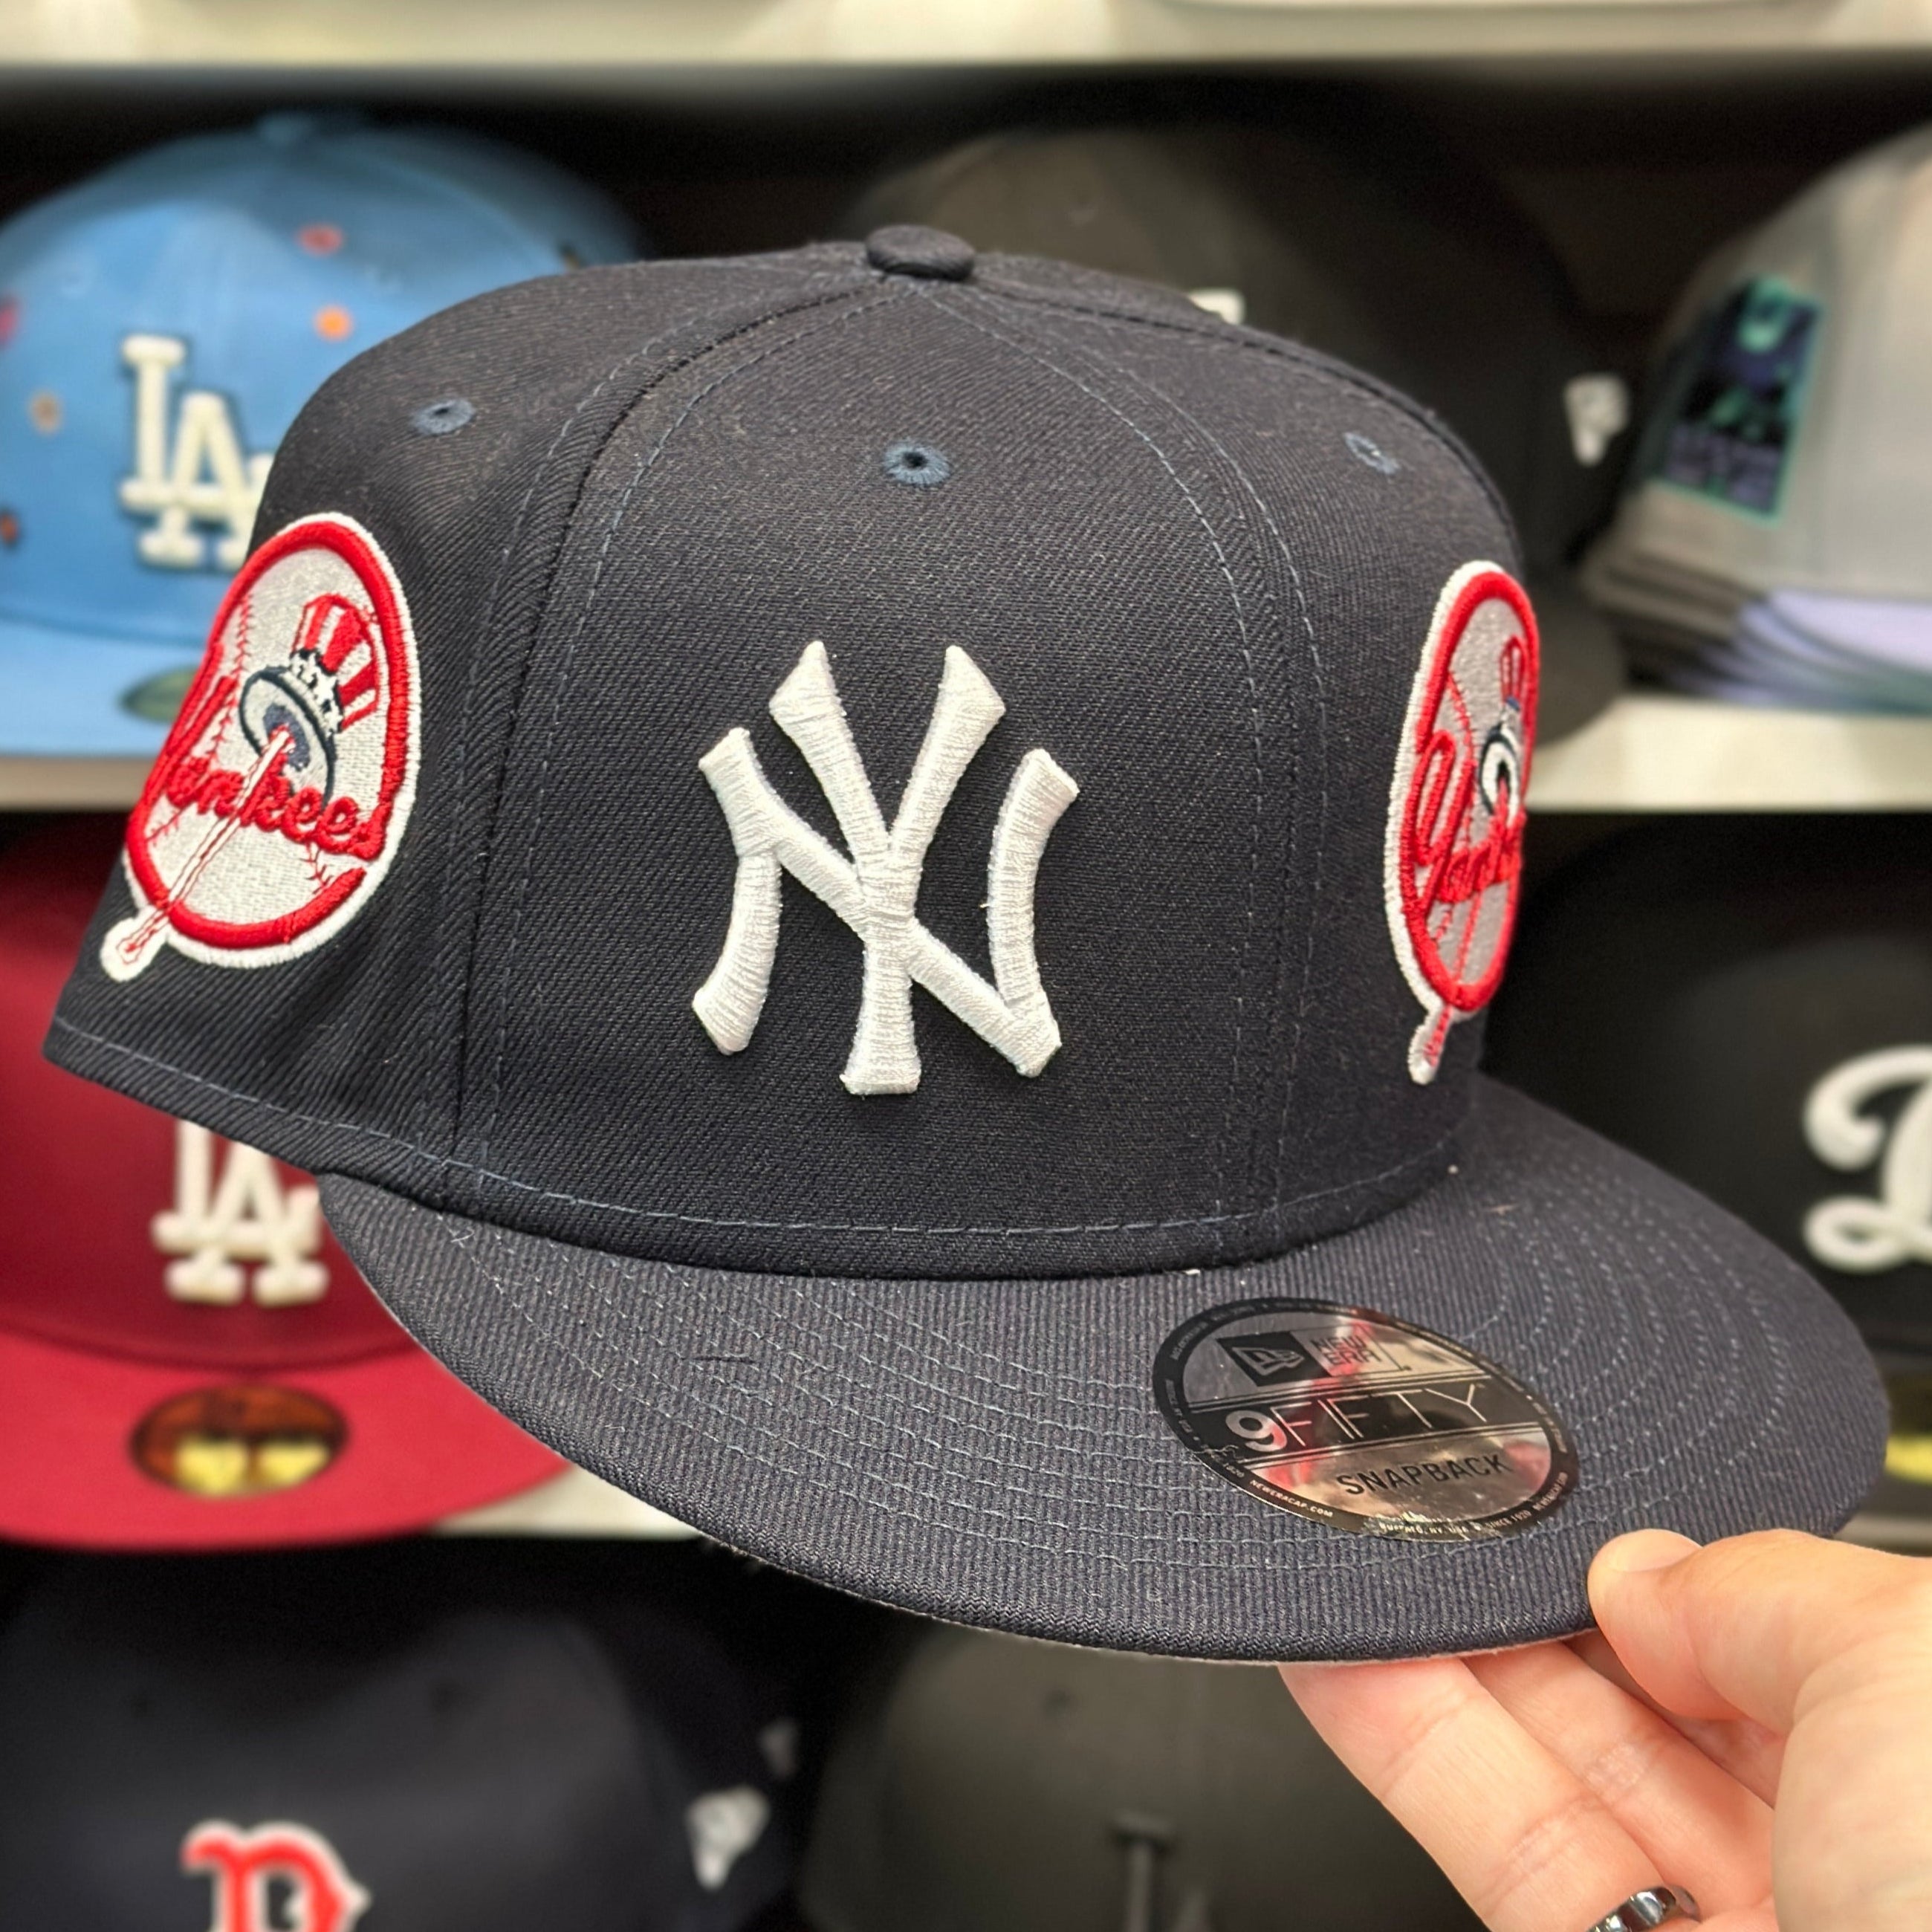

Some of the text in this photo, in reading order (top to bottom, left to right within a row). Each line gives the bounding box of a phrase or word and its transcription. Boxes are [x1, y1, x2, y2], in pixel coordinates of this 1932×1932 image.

[120, 333, 276, 571] LA
[693, 641, 1080, 1095] NY
[153, 1120, 328, 1306] LA
[1309, 1335, 1367, 1352] NEW
[1326, 1349, 1381, 1366] ERA
[1225, 1384, 1487, 1453] 9FIFTY
[1336, 1453, 1513, 1496] SNAPBACK
